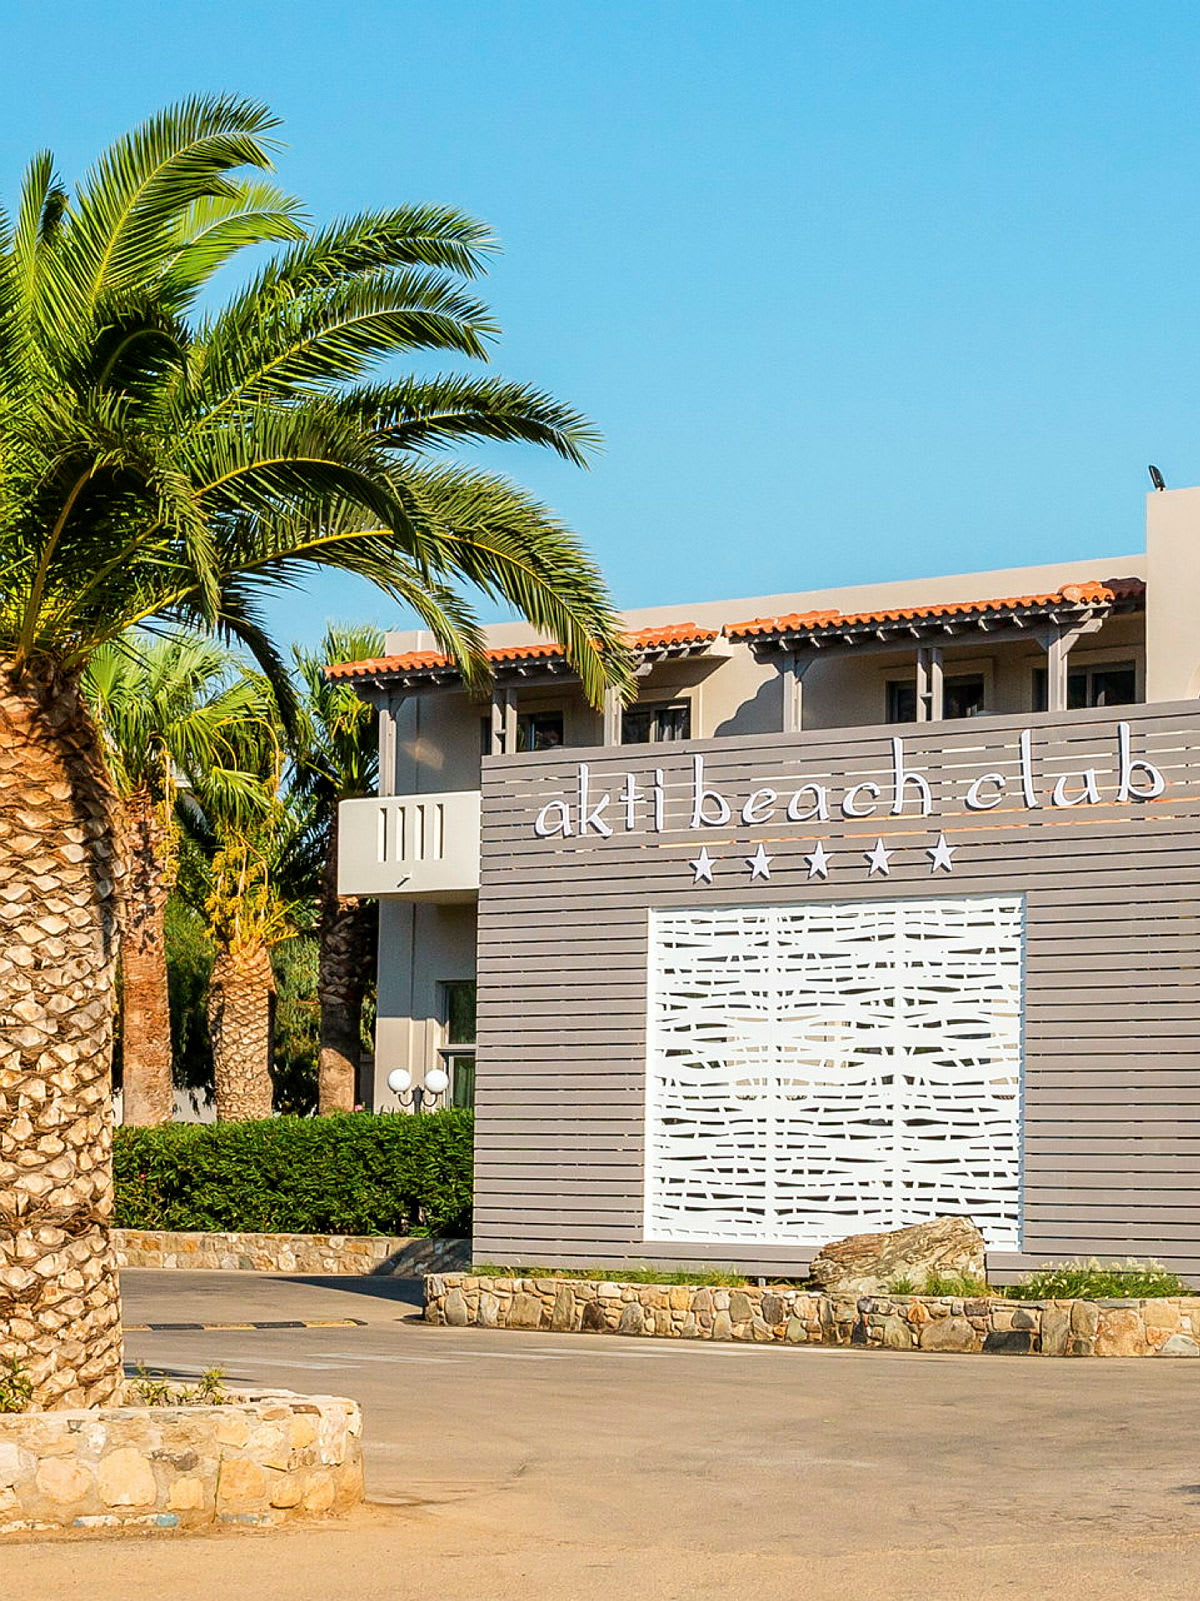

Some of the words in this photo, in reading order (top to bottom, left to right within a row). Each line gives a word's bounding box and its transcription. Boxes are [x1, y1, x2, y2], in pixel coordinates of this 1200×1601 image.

[535, 763, 665, 837] akti
[690, 737, 933, 829] beach
[966, 722, 1165, 809] club
